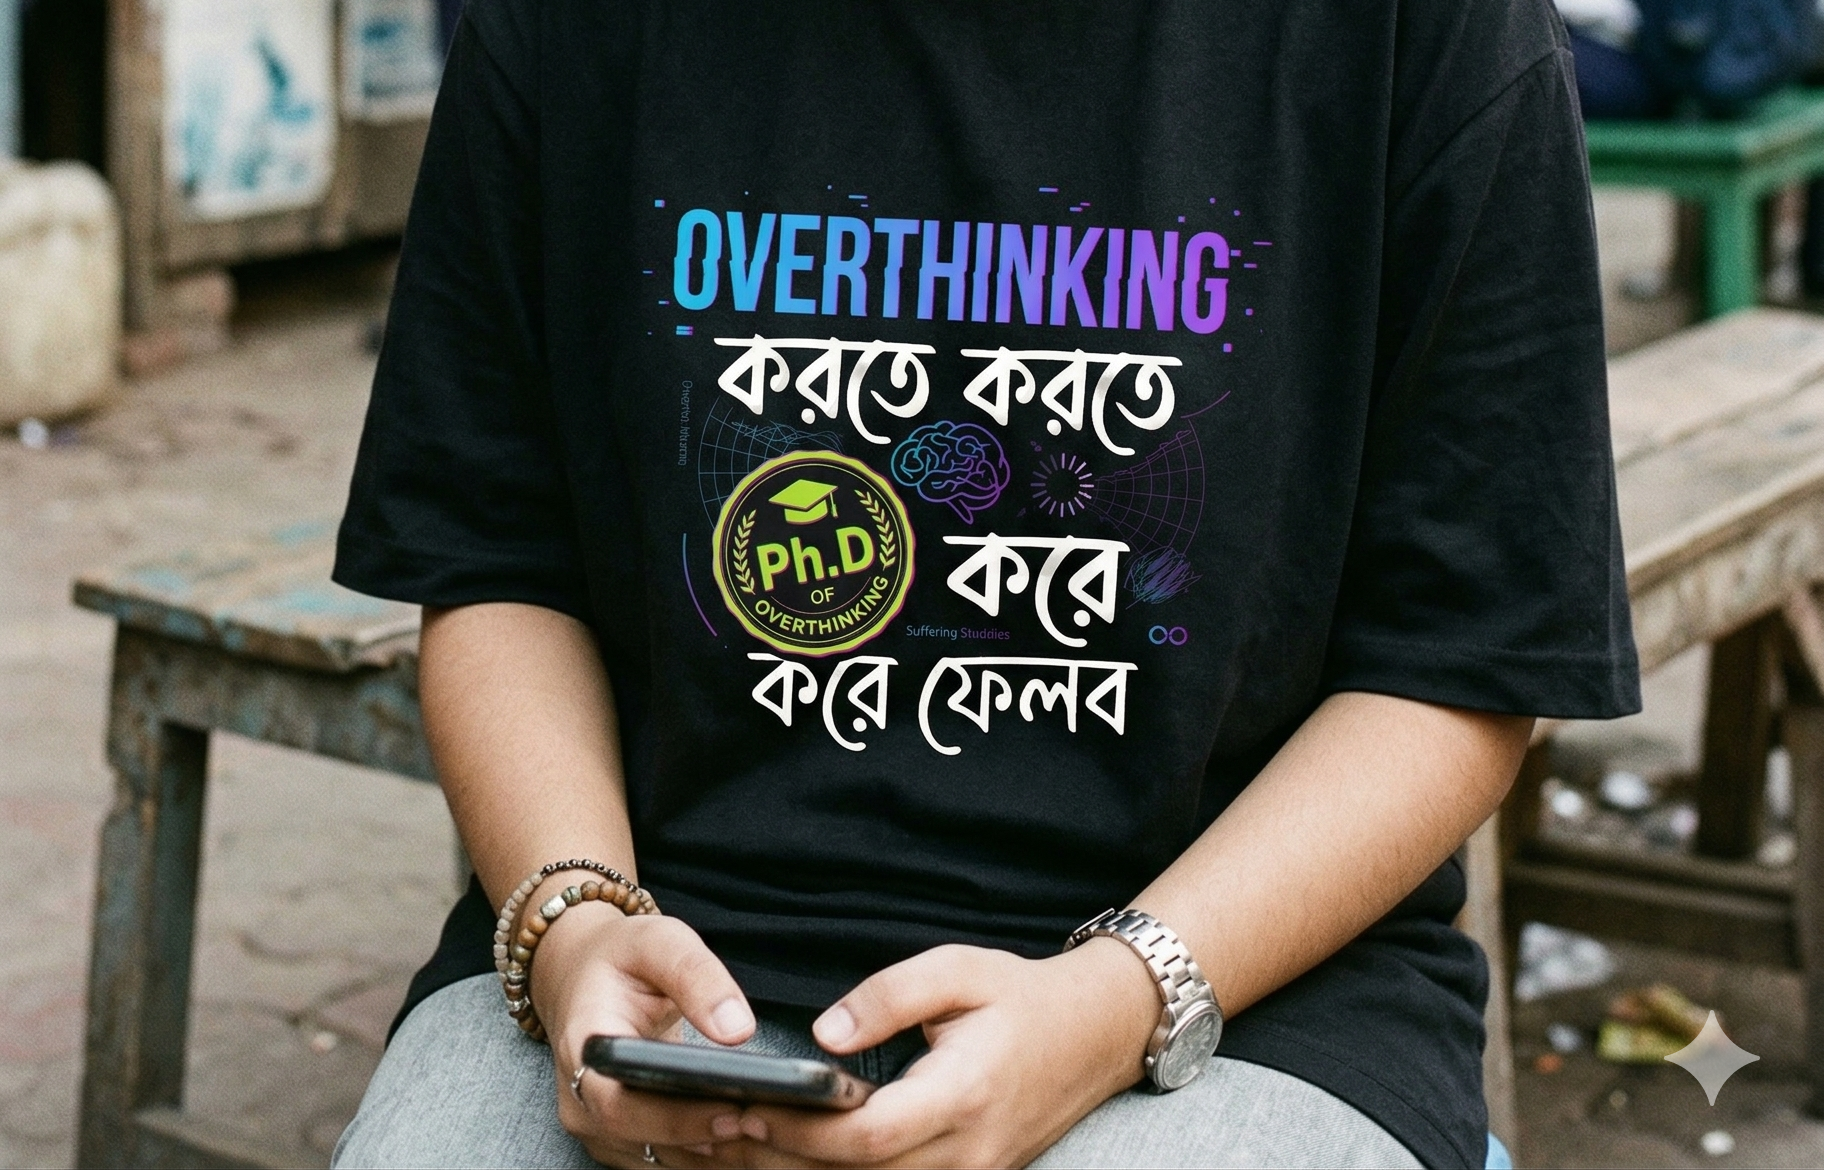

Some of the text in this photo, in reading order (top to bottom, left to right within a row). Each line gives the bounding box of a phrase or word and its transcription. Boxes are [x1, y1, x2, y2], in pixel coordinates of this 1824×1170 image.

[673, 208, 1231, 334] OVERTHINKING
[714, 334, 936, 444] করতে
[961, 346, 1183, 456] করতে
[757, 526, 875, 592] Ph.D
[811, 587, 834, 605] OF
[943, 532, 1130, 647] করে
[755, 575, 888, 636] OVERTHINKING
[906, 625, 958, 641] Suffering
[747, 653, 1139, 756] করে ফেলব
